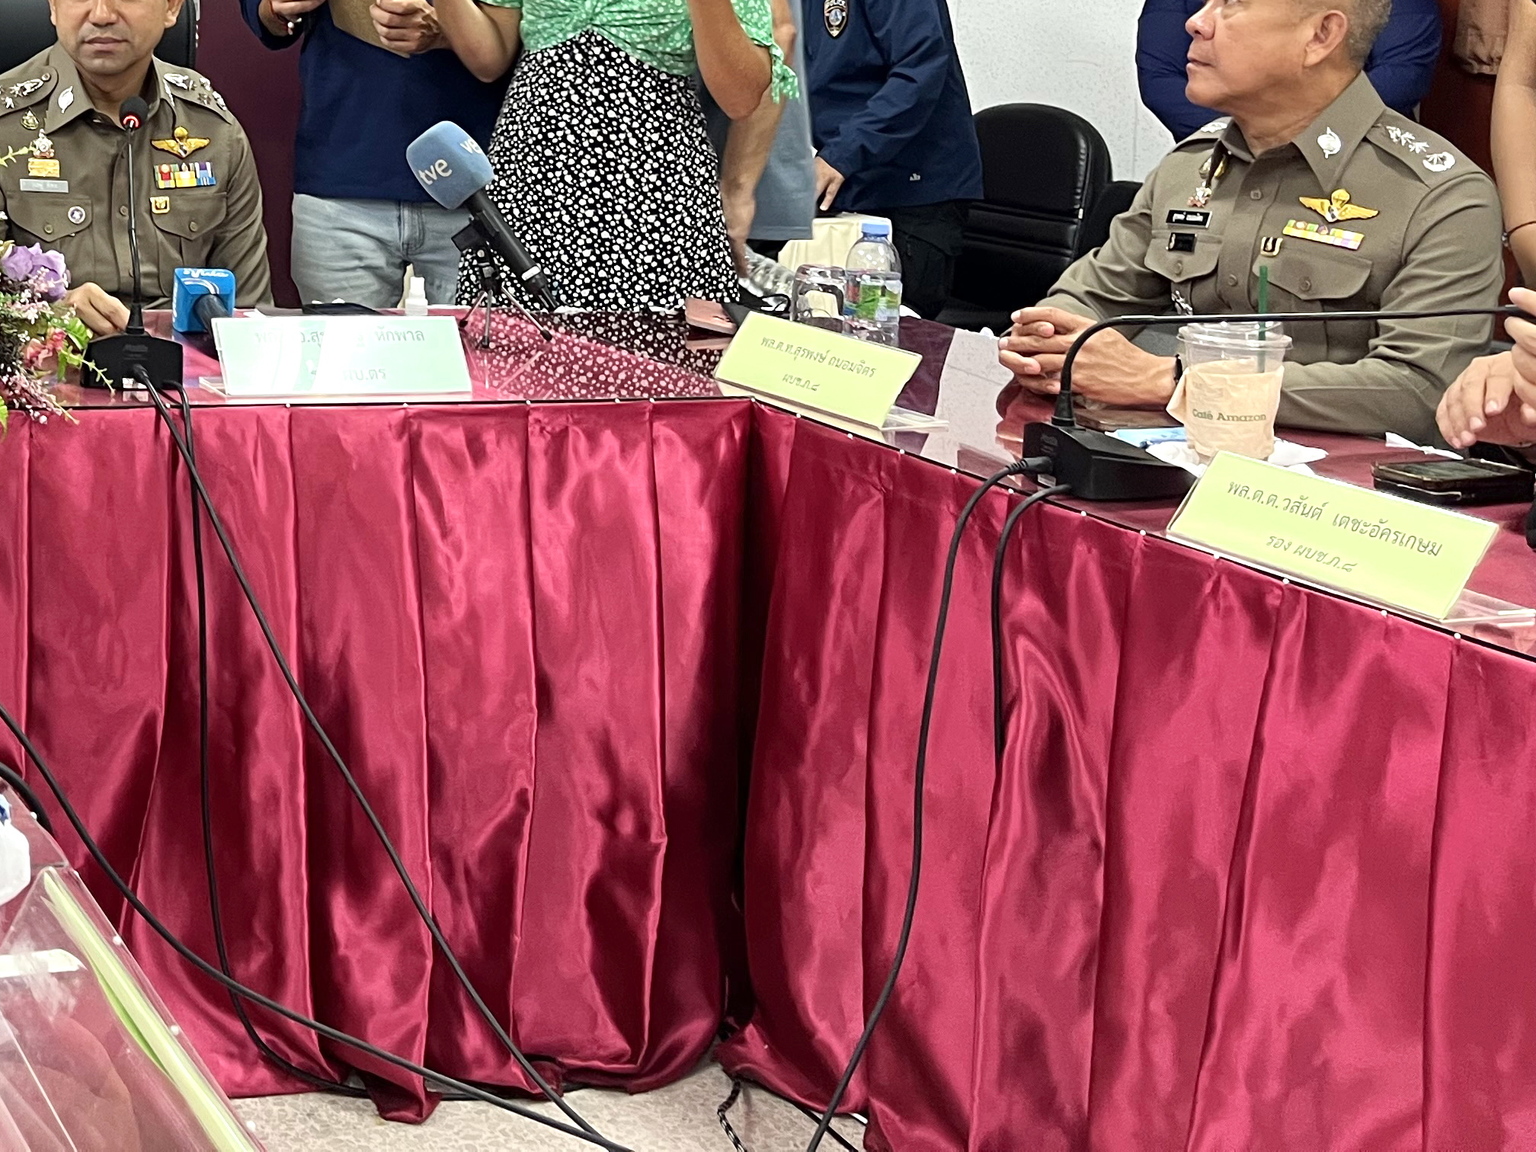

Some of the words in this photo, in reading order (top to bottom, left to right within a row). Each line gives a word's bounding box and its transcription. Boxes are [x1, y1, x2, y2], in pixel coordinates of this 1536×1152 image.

[418, 158, 453, 186] tve
[1217, 412, 1267, 422] Amazon
[1266, 535, 1293, 552] รอง
